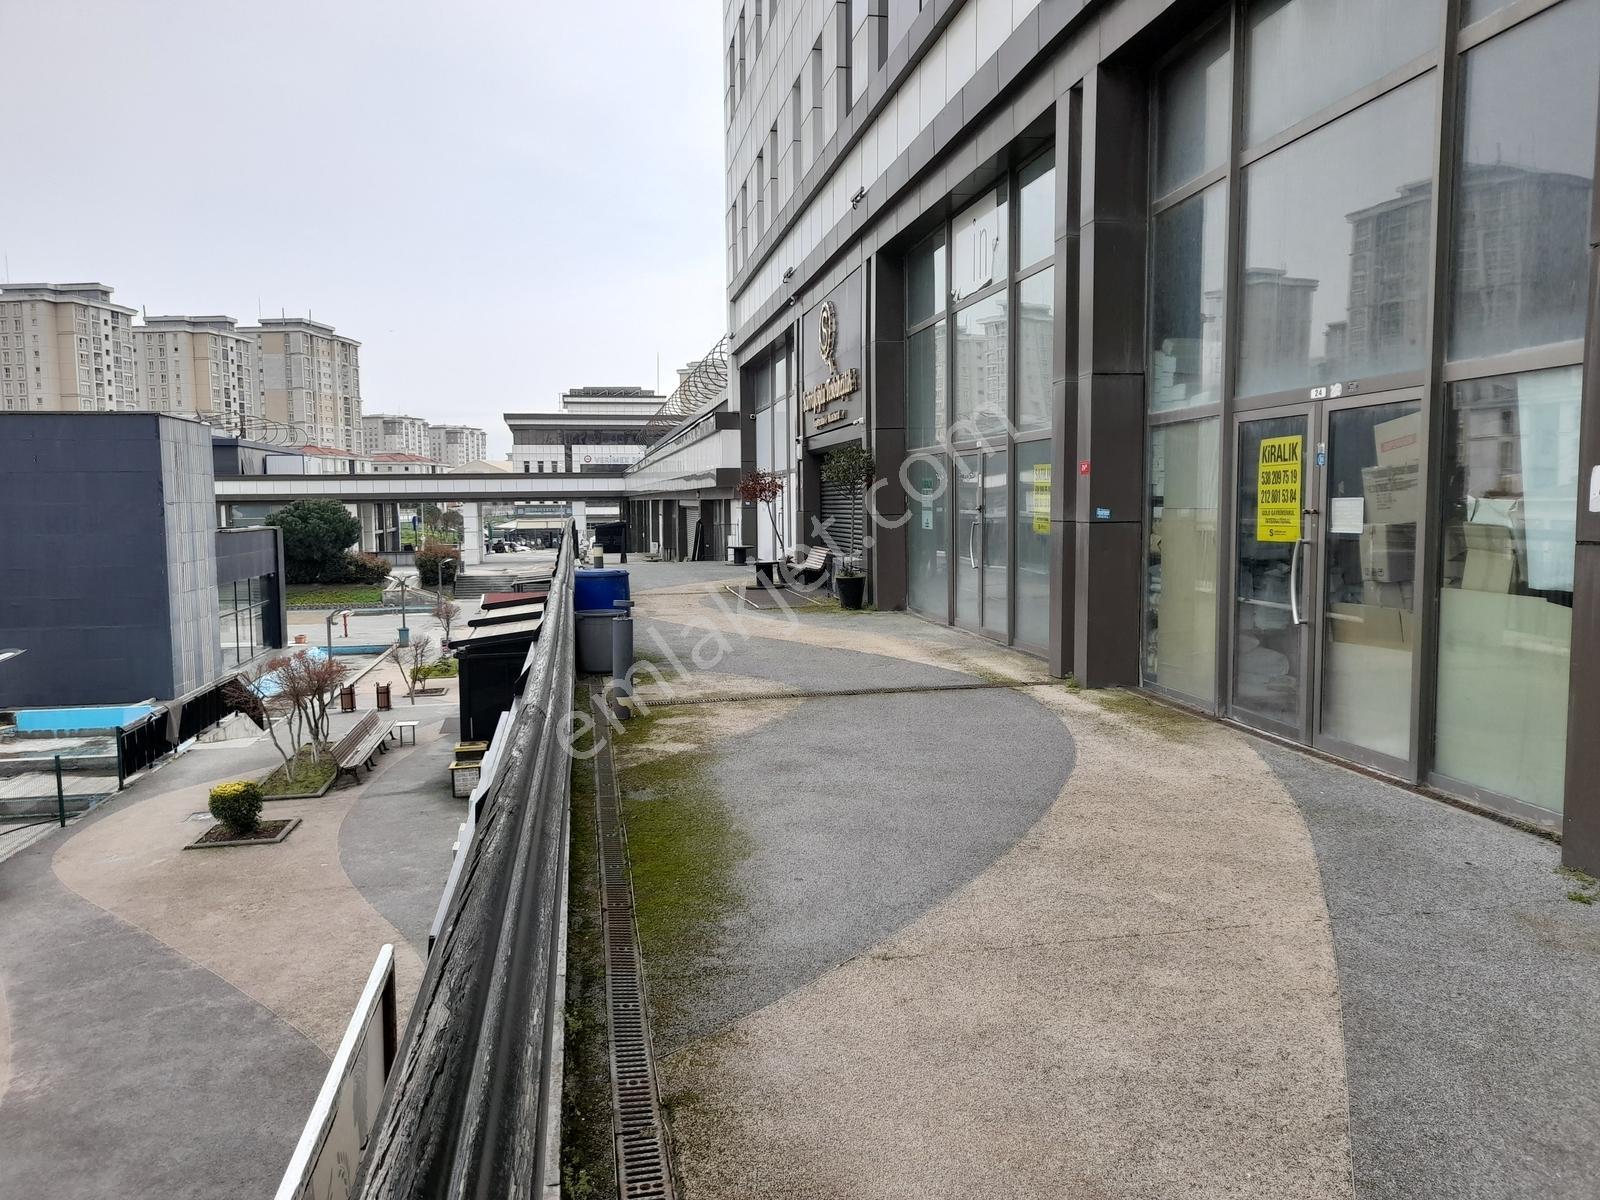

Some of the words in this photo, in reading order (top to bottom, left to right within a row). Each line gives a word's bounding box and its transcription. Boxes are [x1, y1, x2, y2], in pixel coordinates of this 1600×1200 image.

[1282, 469, 1290, 484] 75
[1290, 469, 1297, 484] 19
[1261, 489, 1271, 503] 212
[1281, 489, 1289, 503] 53
[1289, 488, 1297, 503] 84
